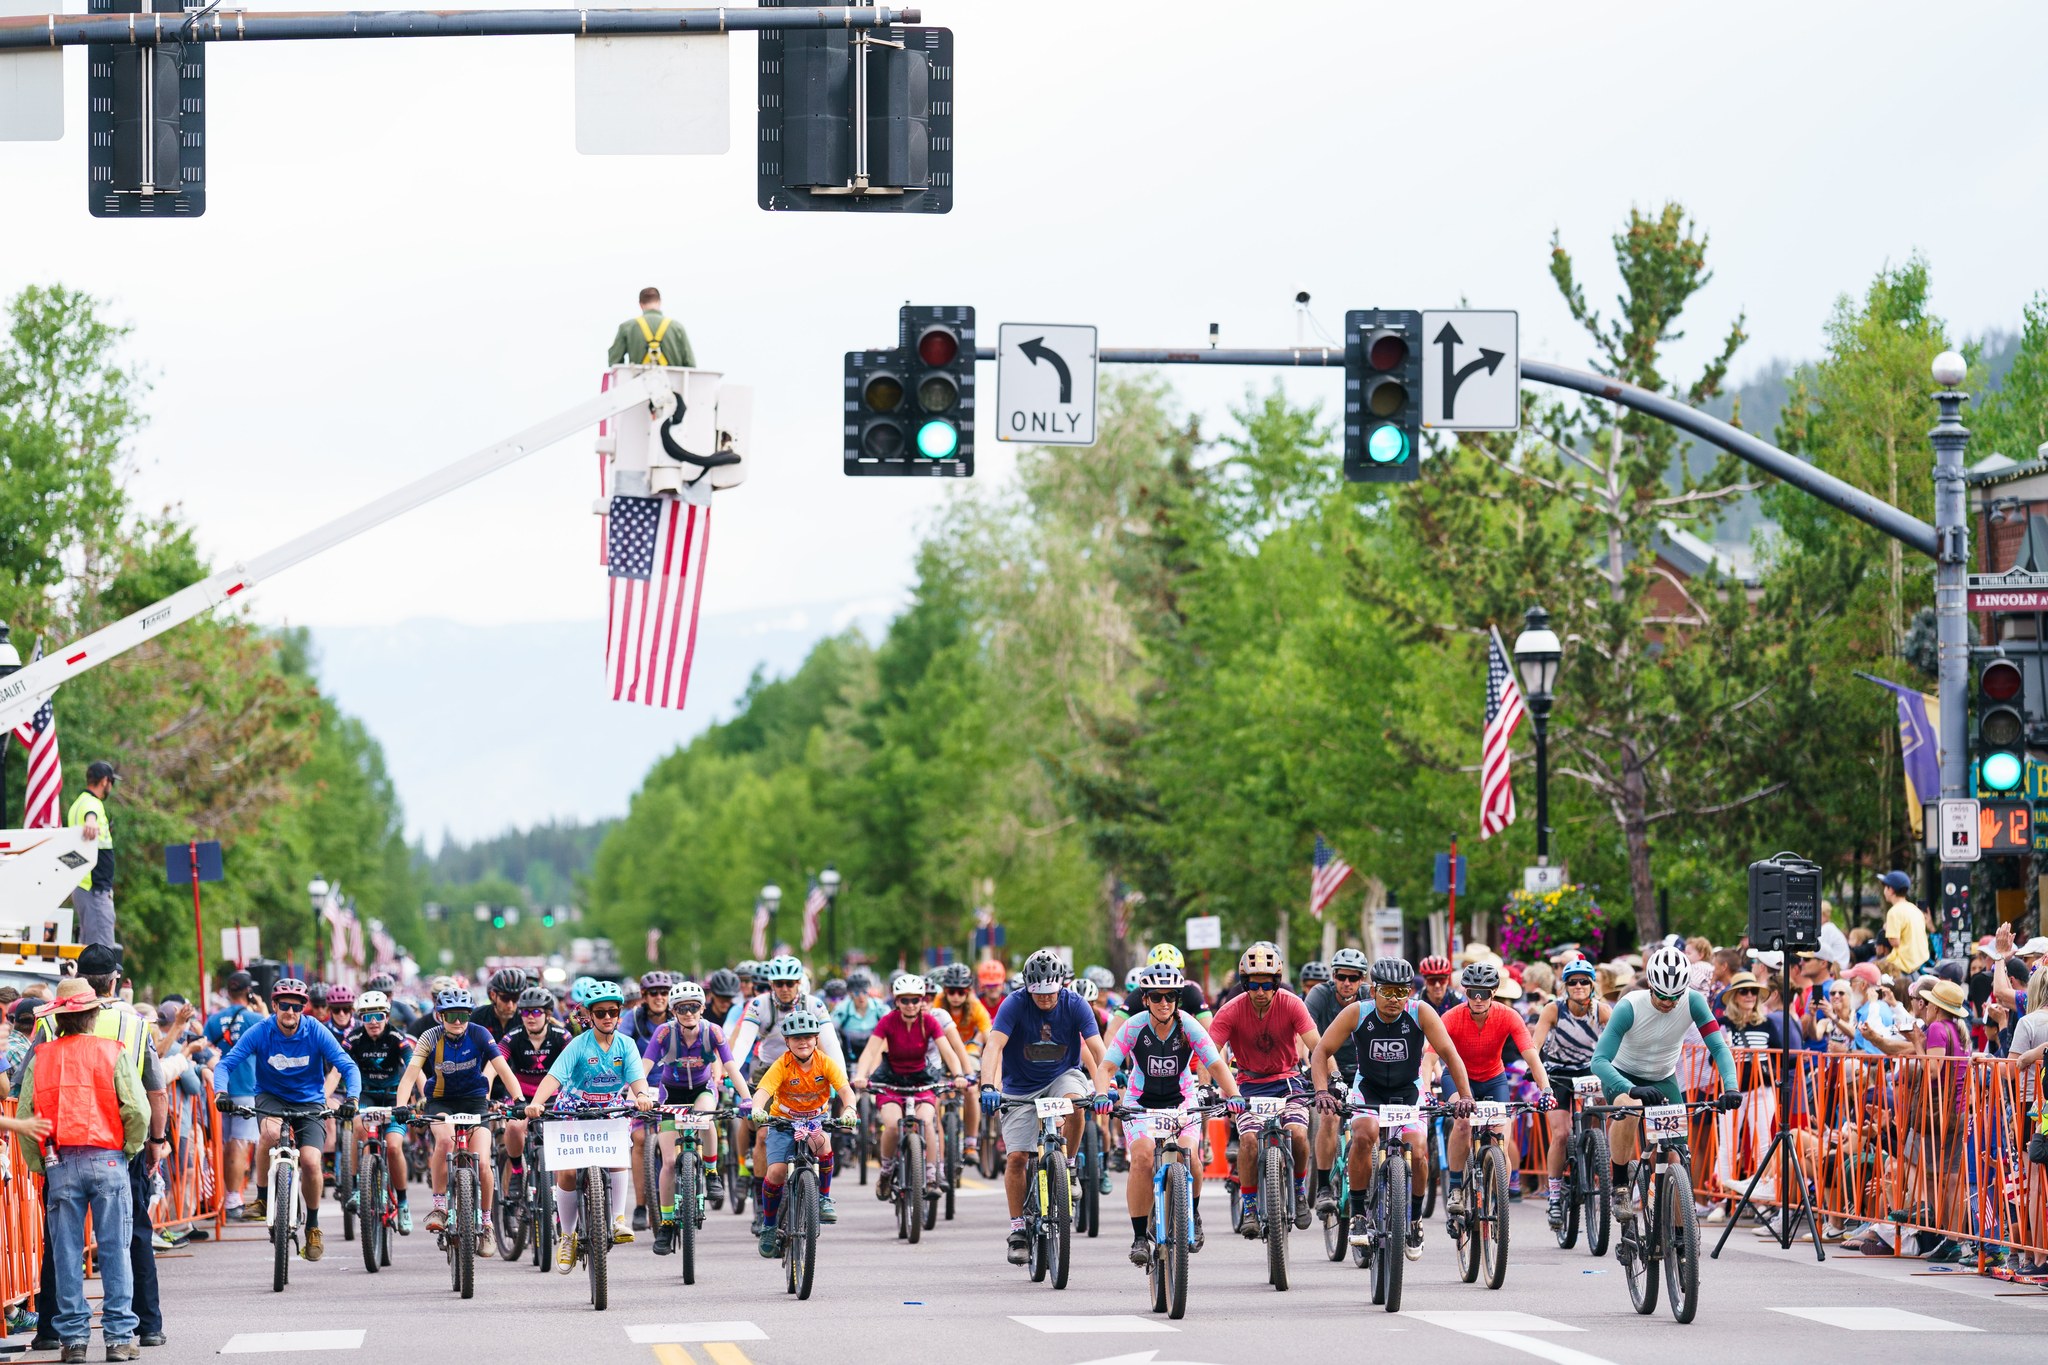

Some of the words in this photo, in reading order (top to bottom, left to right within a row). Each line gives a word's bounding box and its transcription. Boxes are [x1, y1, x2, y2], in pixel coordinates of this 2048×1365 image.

[1012, 411, 1081, 433] ONLY
[1976, 594, 2037, 607] LINCOLN
[2010, 810, 2028, 844] 12
[1373, 1041, 1404, 1052] NO
[1150, 1058, 1176, 1070] NO
[1043, 1101, 1065, 1111] 542
[1257, 1102, 1278, 1114] 621
[1476, 1106, 1499, 1118] 599
[1387, 1112, 1411, 1122] 554
[1648, 1109, 1676, 1117] FIRECRACKER
[1654, 1115, 1679, 1131] 623
[560, 1133, 579, 1143] Duo
[583, 1131, 609, 1142] Coed
[557, 1147, 584, 1156] Team
[588, 1145, 617, 1154] Relay
